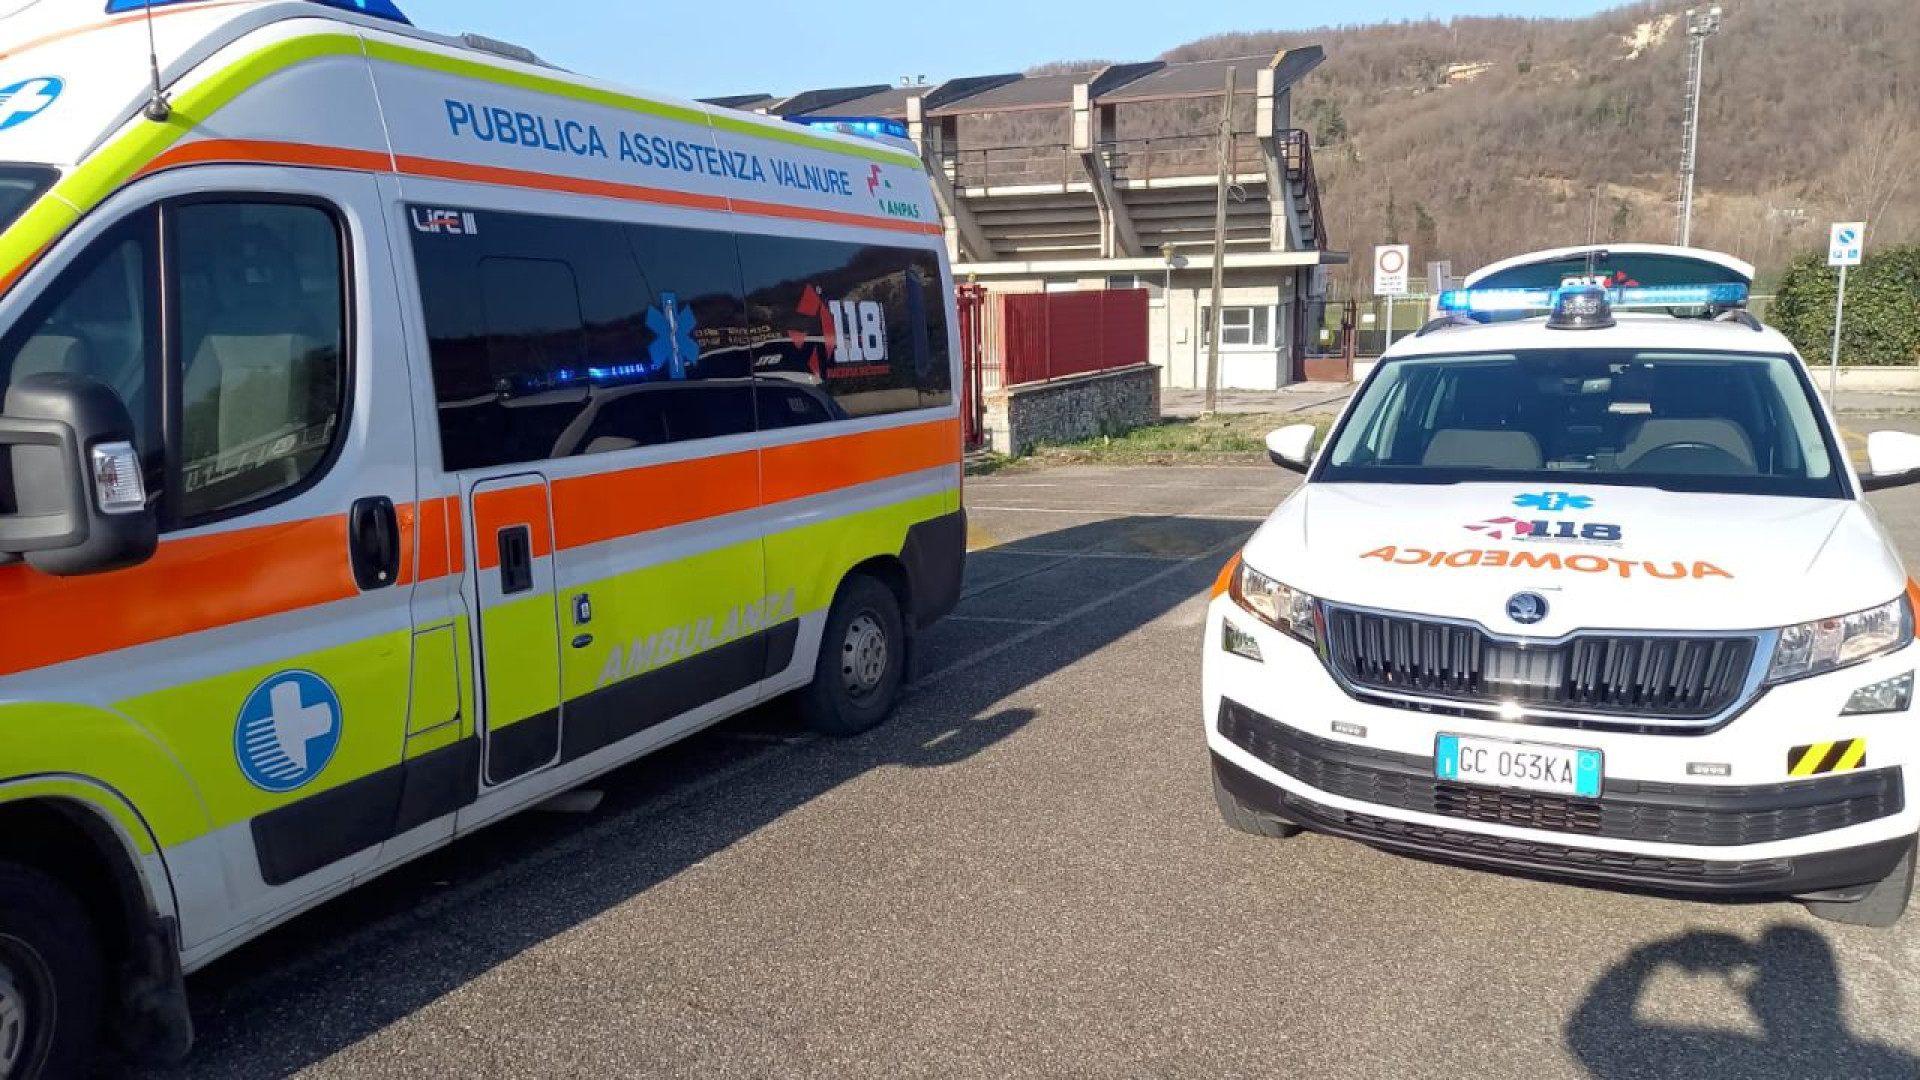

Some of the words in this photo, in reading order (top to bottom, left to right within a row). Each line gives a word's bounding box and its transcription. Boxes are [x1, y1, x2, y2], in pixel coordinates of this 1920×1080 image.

[445, 99, 607, 158] PUBBLICA
[619, 131, 766, 183] ASSISTENZA
[769, 158, 853, 196] VALNURE
[887, 200, 919, 219] ANPAS
[828, 299, 885, 362] 118
[1527, 519, 1622, 541] 118
[596, 586, 796, 687] AMBULANZA
[1460, 746, 1489, 774] GC
[1498, 751, 1574, 785] 053KA
